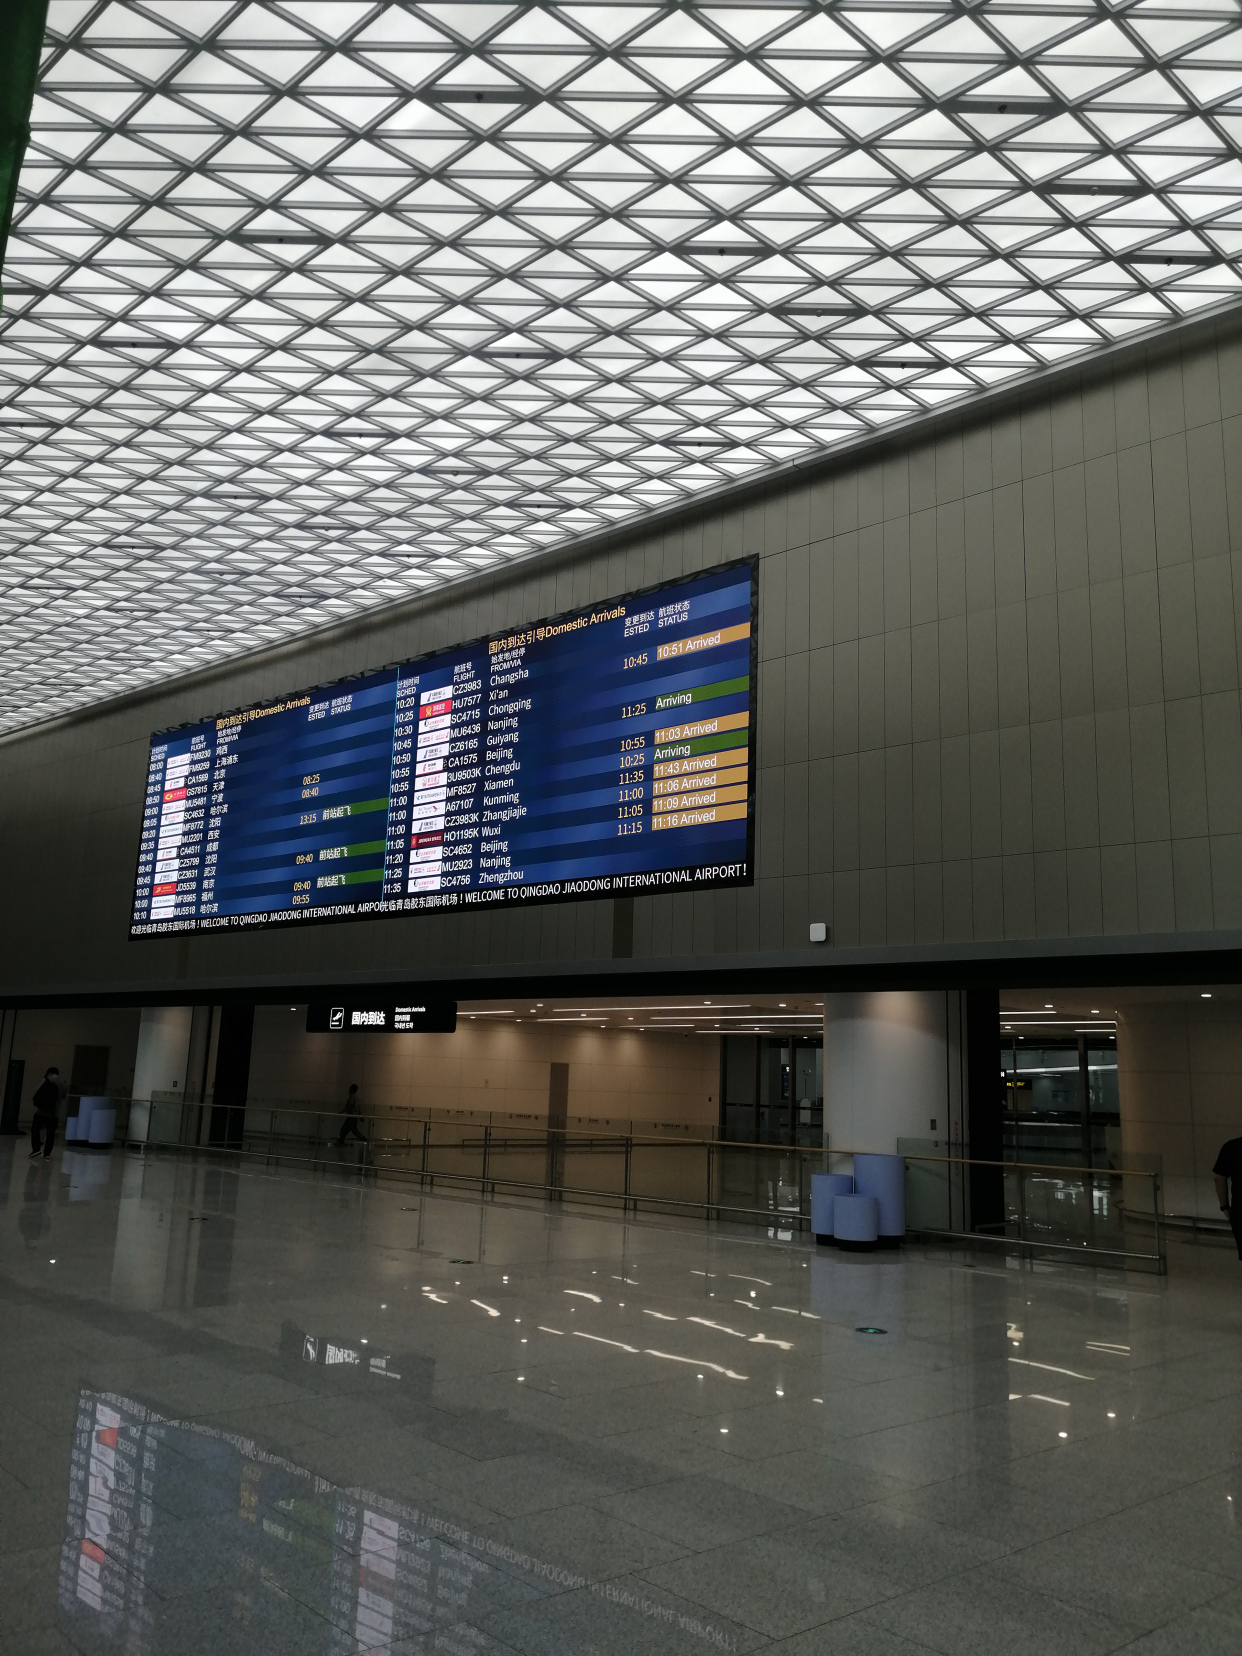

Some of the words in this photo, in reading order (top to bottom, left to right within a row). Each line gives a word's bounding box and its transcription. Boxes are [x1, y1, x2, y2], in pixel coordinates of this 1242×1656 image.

[658, 600, 690, 618] 航班状态
[658, 612, 688, 628] STATUS
[488, 628, 545, 655] 国内到达引导
[545, 617, 588, 638] Domestic
[589, 605, 626, 625] Arrivals
[624, 623, 649, 637] ESTED
[658, 644, 682, 658] 10:51
[686, 633, 720, 651] Arrived
[623, 653, 648, 669] 10:45
[454, 671, 475, 682] FLIGHT
[490, 669, 528, 686] Changsha
[397, 687, 416, 698] SCHED
[453, 680, 481, 694] CZ3983
[452, 694, 481, 709] HU7577
[489, 689, 508, 701] Xi'an
[656, 693, 692, 709] Arriving
[256, 703, 285, 719] Domestic
[286, 696, 310, 710] Arrivals
[331, 704, 351, 715] STATUS
[397, 698, 414, 709] 10:20
[488, 699, 531, 716] Chongqing
[308, 711, 325, 721] ESTED
[396, 711, 413, 723] 10:25
[451, 709, 480, 724] SC4715
[622, 703, 646, 718] 11:25
[488, 716, 518, 730] Nanjing
[395, 725, 412, 737] 10:30
[450, 724, 480, 738] MU6436
[655, 729, 680, 742] 11:03
[683, 720, 718, 737] Arrived
[394, 739, 411, 751] 10:45
[487, 732, 519, 745] Guiyang
[620, 737, 645, 751] 10:55
[450, 739, 478, 752] CZ6165
[486, 748, 513, 761] Beijing
[654, 745, 690, 760] Arriving
[393, 754, 410, 765] 10:50
[449, 753, 477, 768] CA1575
[620, 753, 644, 768] 10:25
[655, 764, 679, 776] 11:43
[682, 756, 716, 772] Arrived
[214, 769, 226, 780] 北京
[392, 768, 409, 779] 10:55
[448, 767, 481, 782] 3U9503K
[485, 760, 520, 776] Chengdu
[303, 774, 320, 785] 08:25
[619, 770, 644, 784] 11:35
[654, 780, 679, 793] 11:06
[681, 773, 716, 789] Arrived
[213, 781, 224, 792] 天津
[391, 782, 408, 793] 10:55
[446, 783, 476, 797] MF8527
[484, 778, 513, 791] Xiamen
[302, 787, 318, 798] 08:40
[484, 792, 519, 806] Kunming
[619, 787, 643, 801] 11:00
[390, 796, 407, 807] 11:00
[446, 799, 474, 812] A67107
[653, 798, 678, 811] 11:09
[681, 791, 716, 806] Arrived
[323, 806, 351, 820] 前站起飞
[389, 811, 406, 821] 11:00
[482, 806, 527, 821] Zhangjiajie
[618, 804, 642, 818] 11:05
[300, 814, 316, 824] 13:15
[445, 812, 479, 827] CZ3983K
[653, 815, 678, 828] 11:16
[680, 809, 715, 824] Arrived
[208, 830, 220, 840] 西安
[388, 825, 405, 836] 11:00
[444, 828, 479, 842] HO1195K
[482, 825, 501, 836] Wuxi
[617, 822, 642, 835] 11:15
[180, 845, 200, 856] CA4511
[387, 840, 404, 850] 11:05
[443, 844, 472, 856] SC4652
[481, 841, 508, 852] Beijing
[296, 854, 313, 864] 09:40
[386, 854, 403, 864] 11:20
[480, 856, 511, 868] Nanjing
[442, 860, 472, 872] MU2923
[385, 869, 402, 879] 11:25
[479, 870, 523, 884] Zhengzhou
[294, 881, 310, 891] 09:40
[441, 875, 470, 887] SC4756
[465, 889, 504, 902] WELCOME
[507, 888, 518, 899] TO
[520, 883, 560, 898] QINGDAO
[562, 879, 611, 894] JIAODONG
[613, 872, 692, 889] INTERNATIONAL
[384, 884, 401, 894] 11:35
[293, 894, 309, 904] 09:55
[201, 917, 229, 928] WELCOME
[231, 916, 238, 925] TO
[240, 913, 267, 926] QINGDAO
[269, 910, 301, 922] JIAODONG
[302, 904, 356, 918] INTERNATIONAL
[352, 1012, 385, 1025] 国内到达
